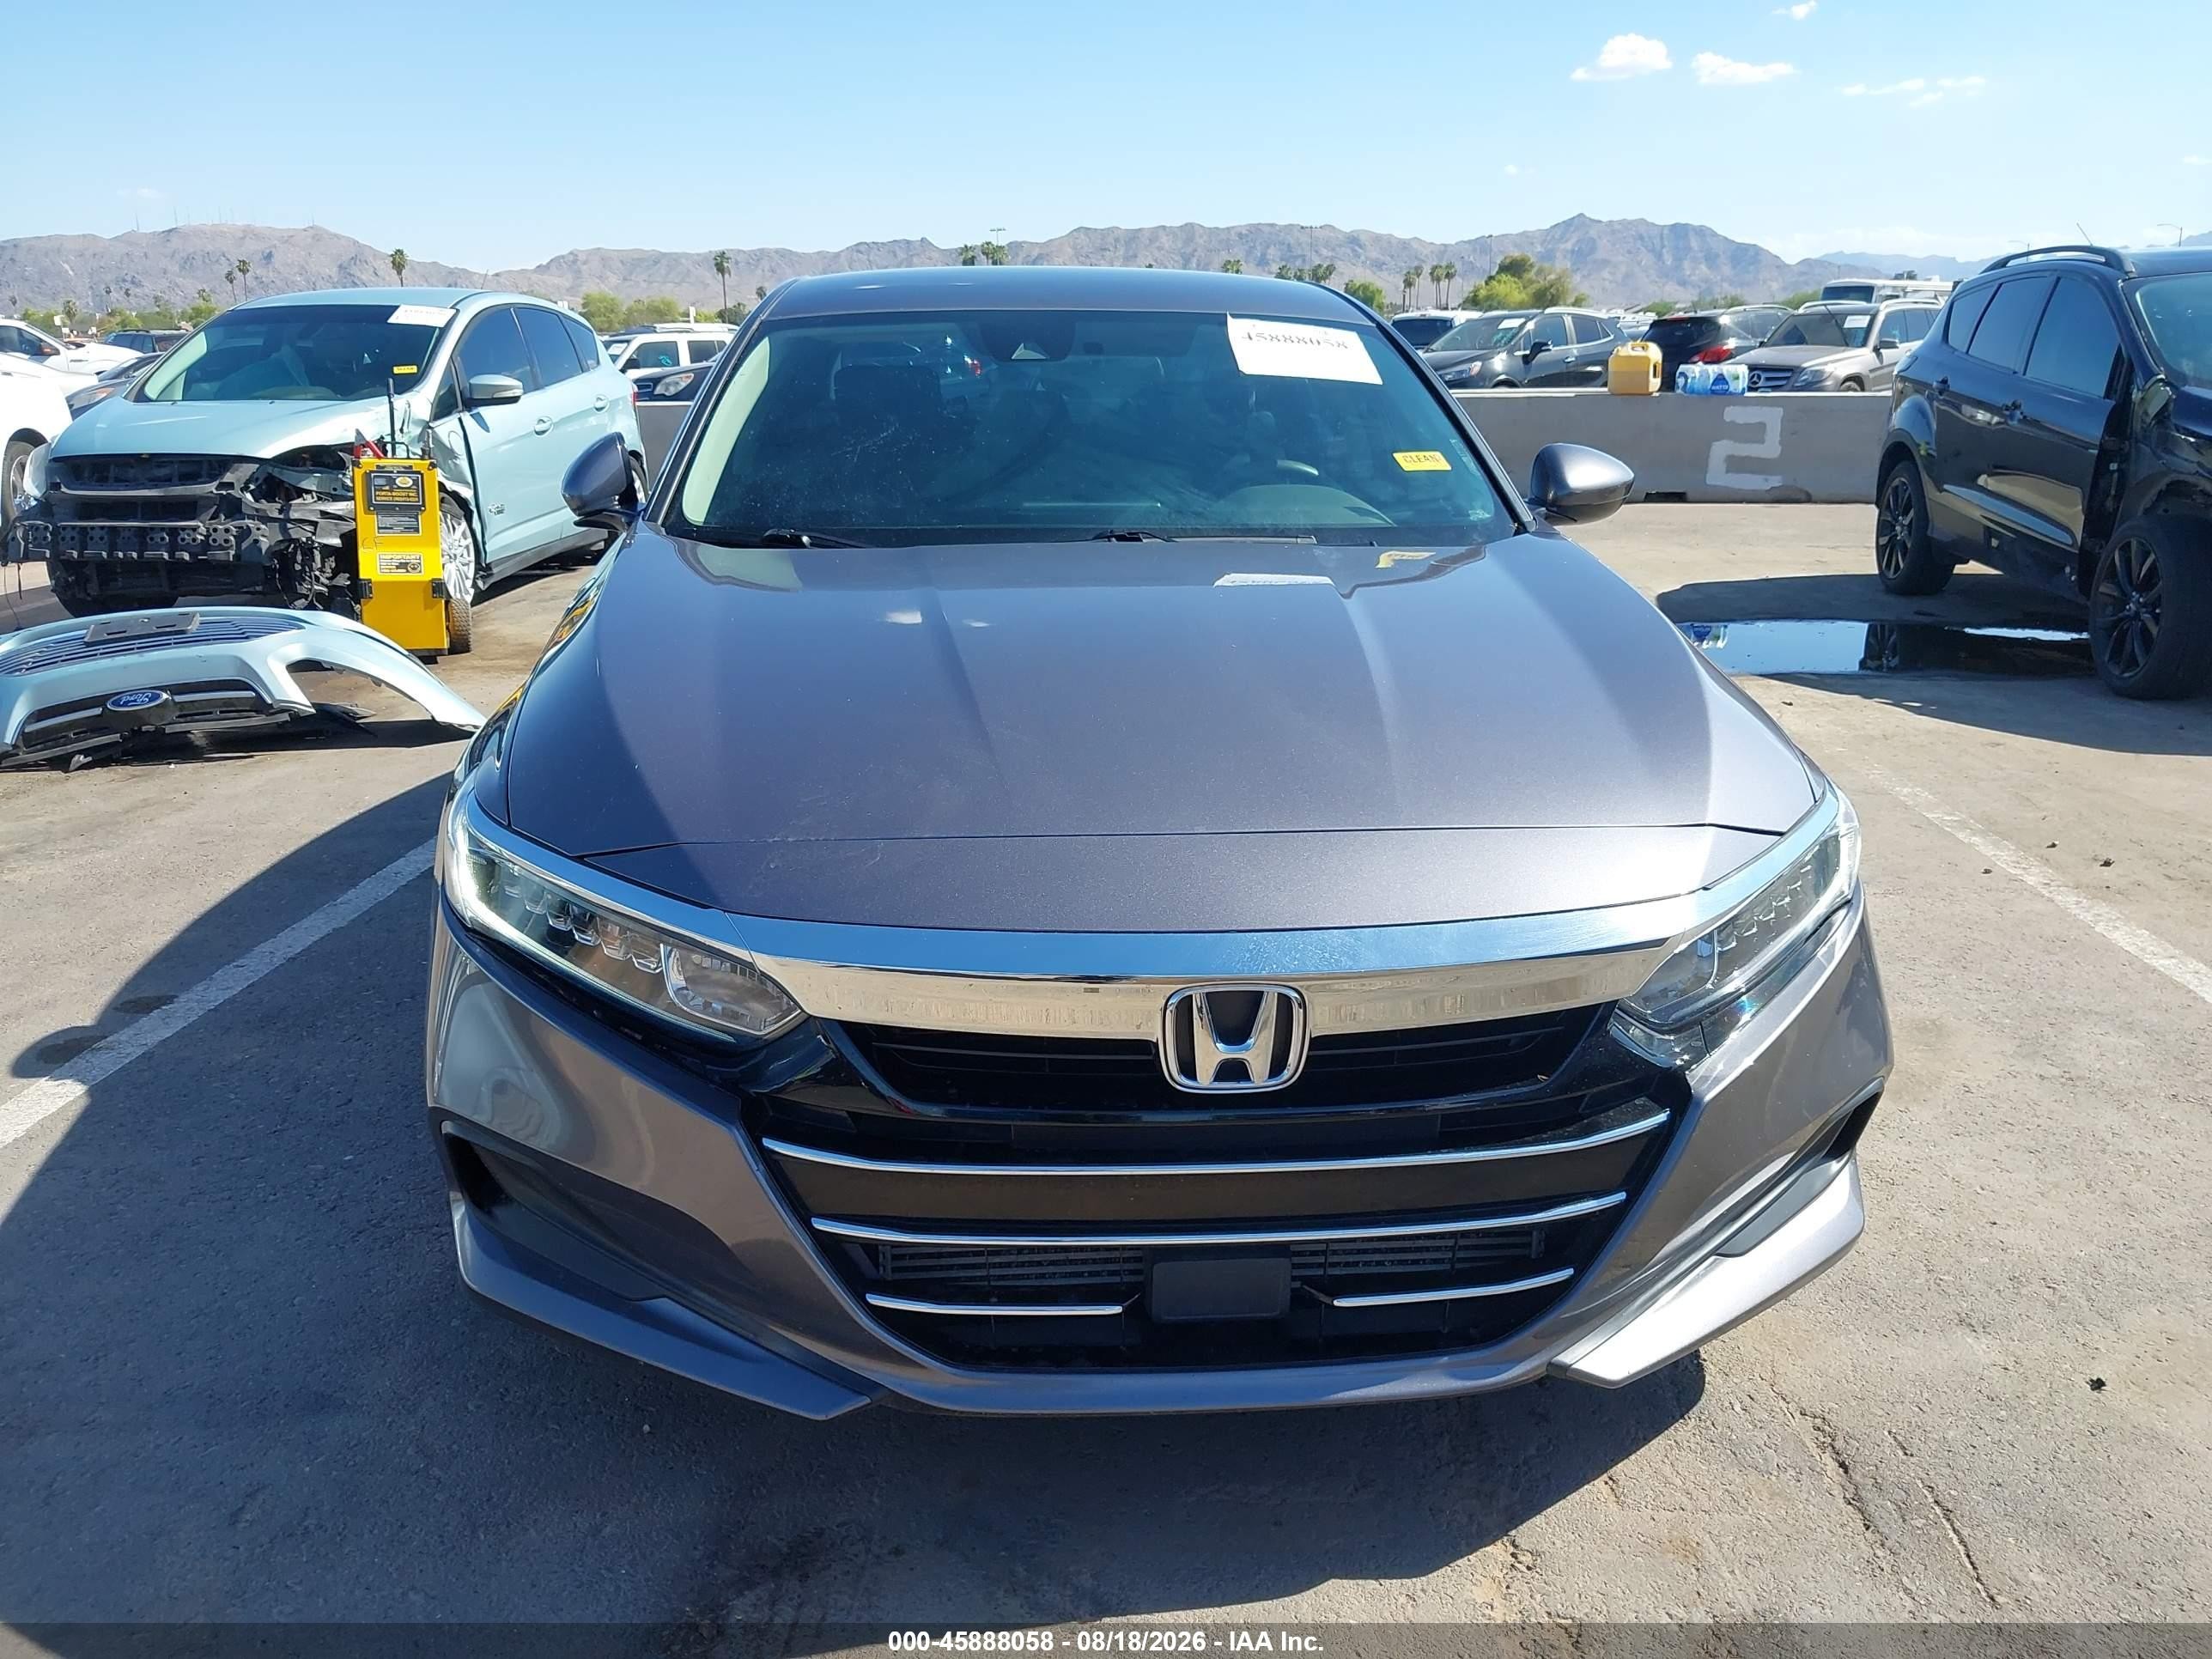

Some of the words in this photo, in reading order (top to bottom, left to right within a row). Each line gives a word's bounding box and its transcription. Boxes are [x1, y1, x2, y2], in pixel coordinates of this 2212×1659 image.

[1705, 405, 1784, 490] 2
[1402, 454, 1440, 464] CLEAN
[120, 693, 152, 705] Ford
